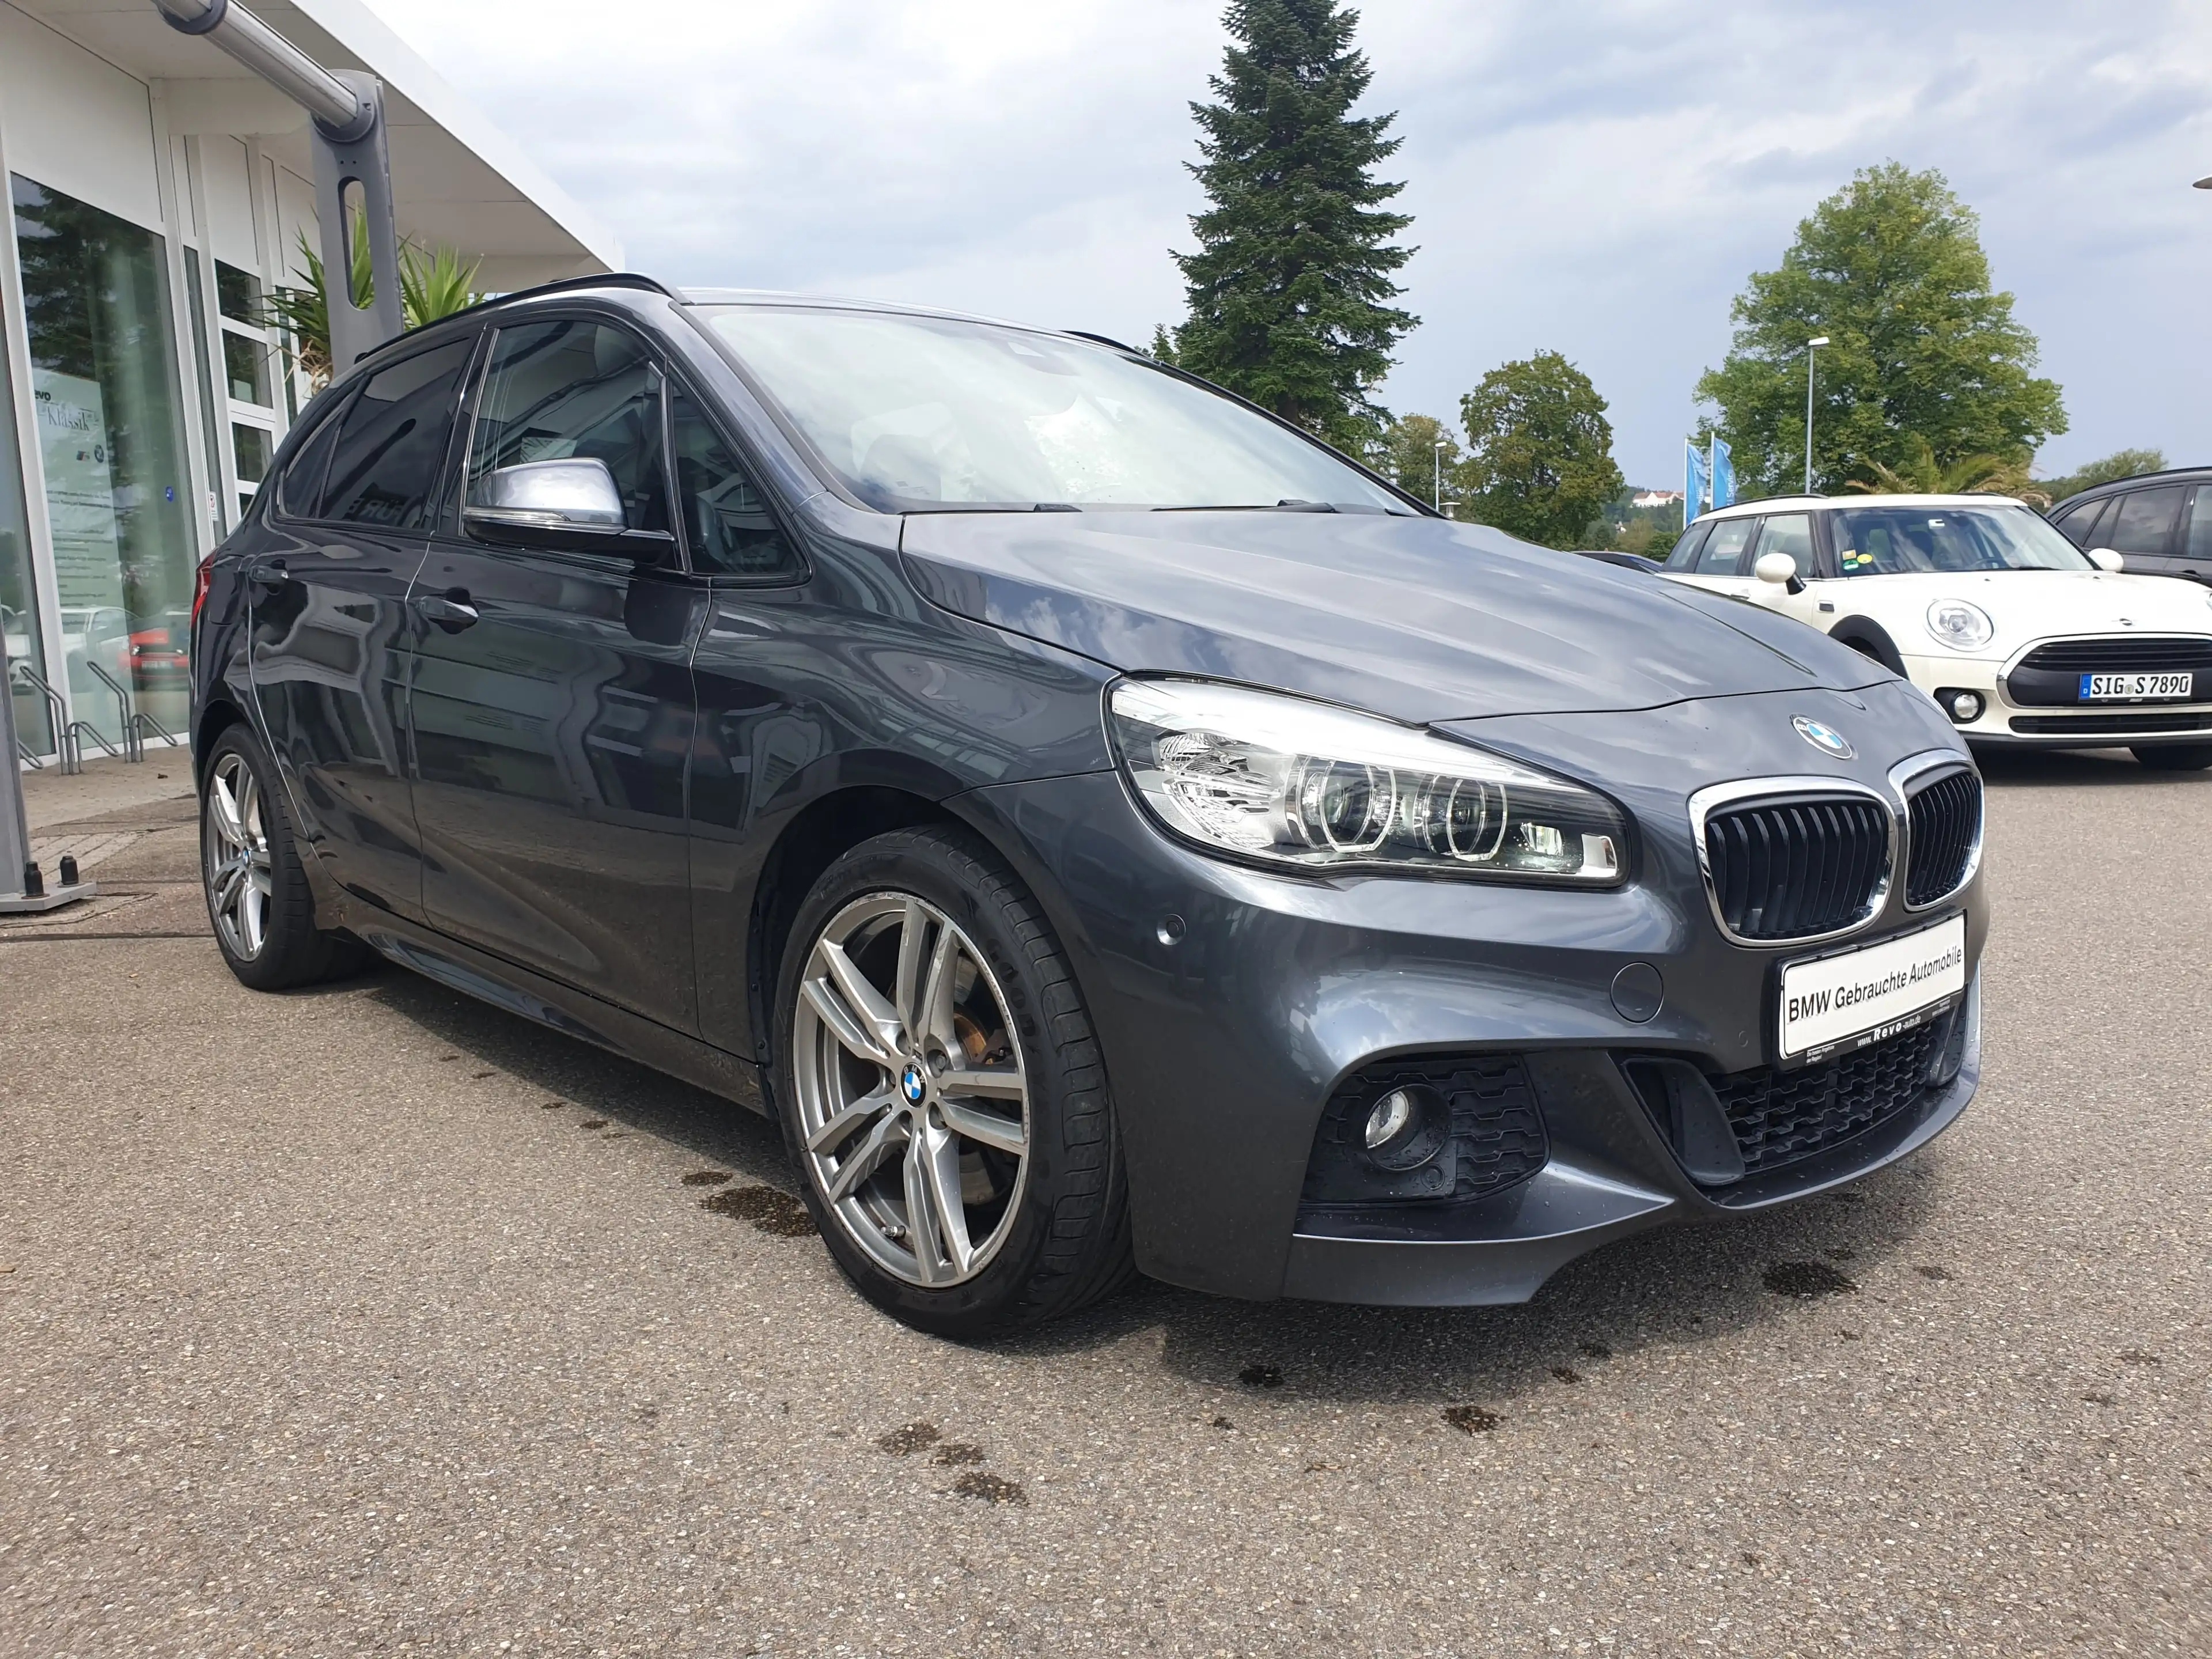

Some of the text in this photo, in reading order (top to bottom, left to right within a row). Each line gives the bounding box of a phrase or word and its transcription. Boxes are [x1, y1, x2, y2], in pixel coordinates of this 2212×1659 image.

[35, 389, 51, 401] evo
[47, 406, 89, 431] Klassik
[1726, 468, 1734, 498] Servic
[2092, 676, 2124, 695] SIG
[1789, 945, 1961, 1022] BMW Gebrauchte Automobile
[904, 1065, 925, 1083] BMW
